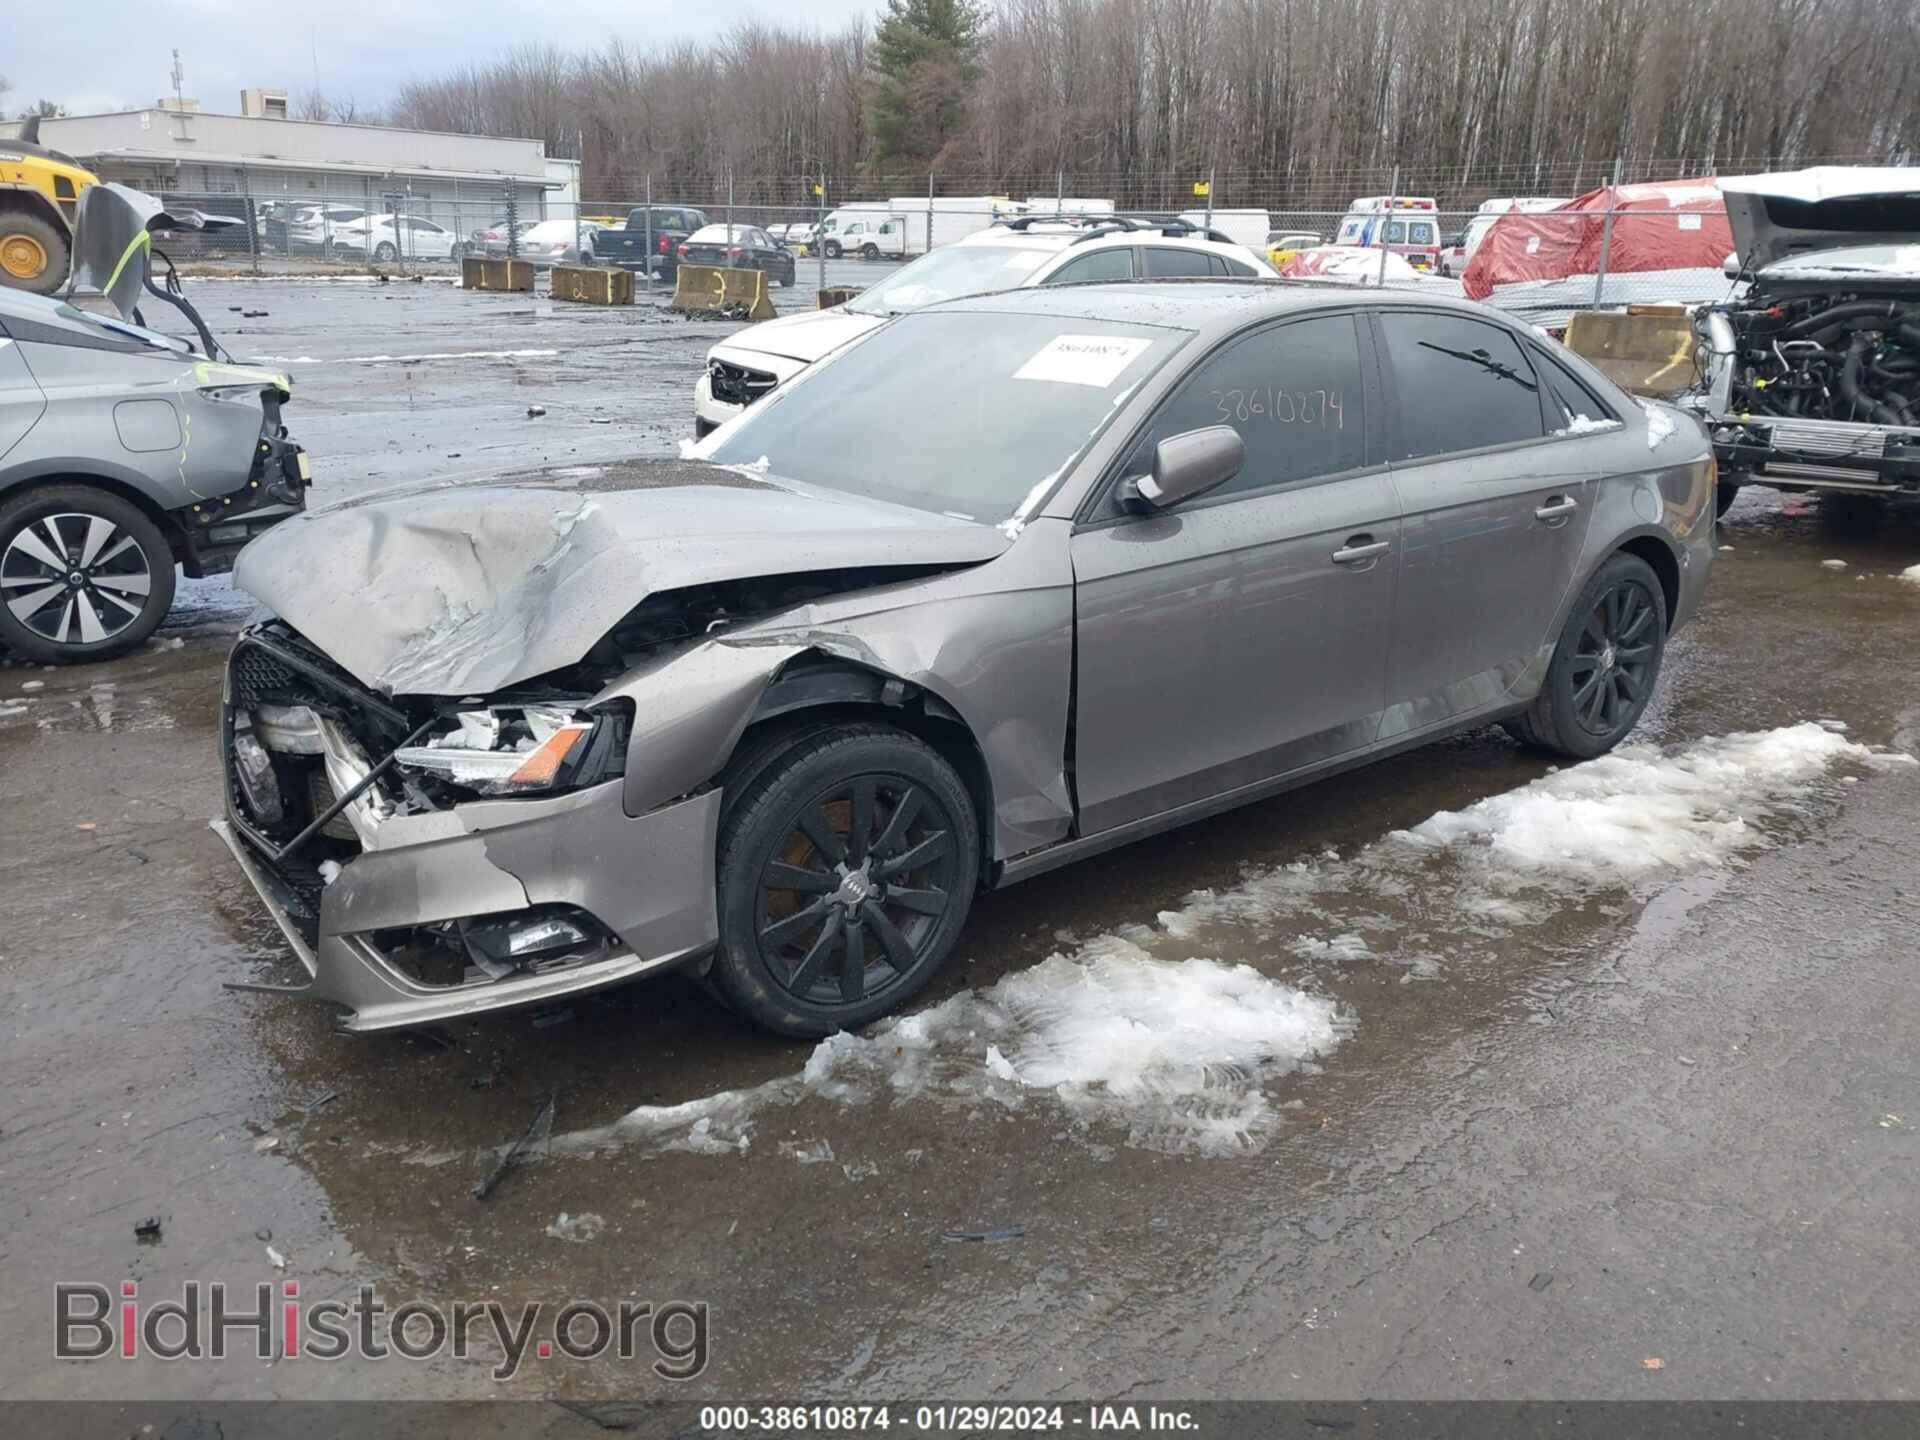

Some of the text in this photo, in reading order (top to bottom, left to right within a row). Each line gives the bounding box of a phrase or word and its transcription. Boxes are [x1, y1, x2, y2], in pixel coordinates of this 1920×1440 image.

[572, 272, 589, 300] 2
[709, 271, 728, 308] 3
[1210, 384, 1344, 431] 38610874
